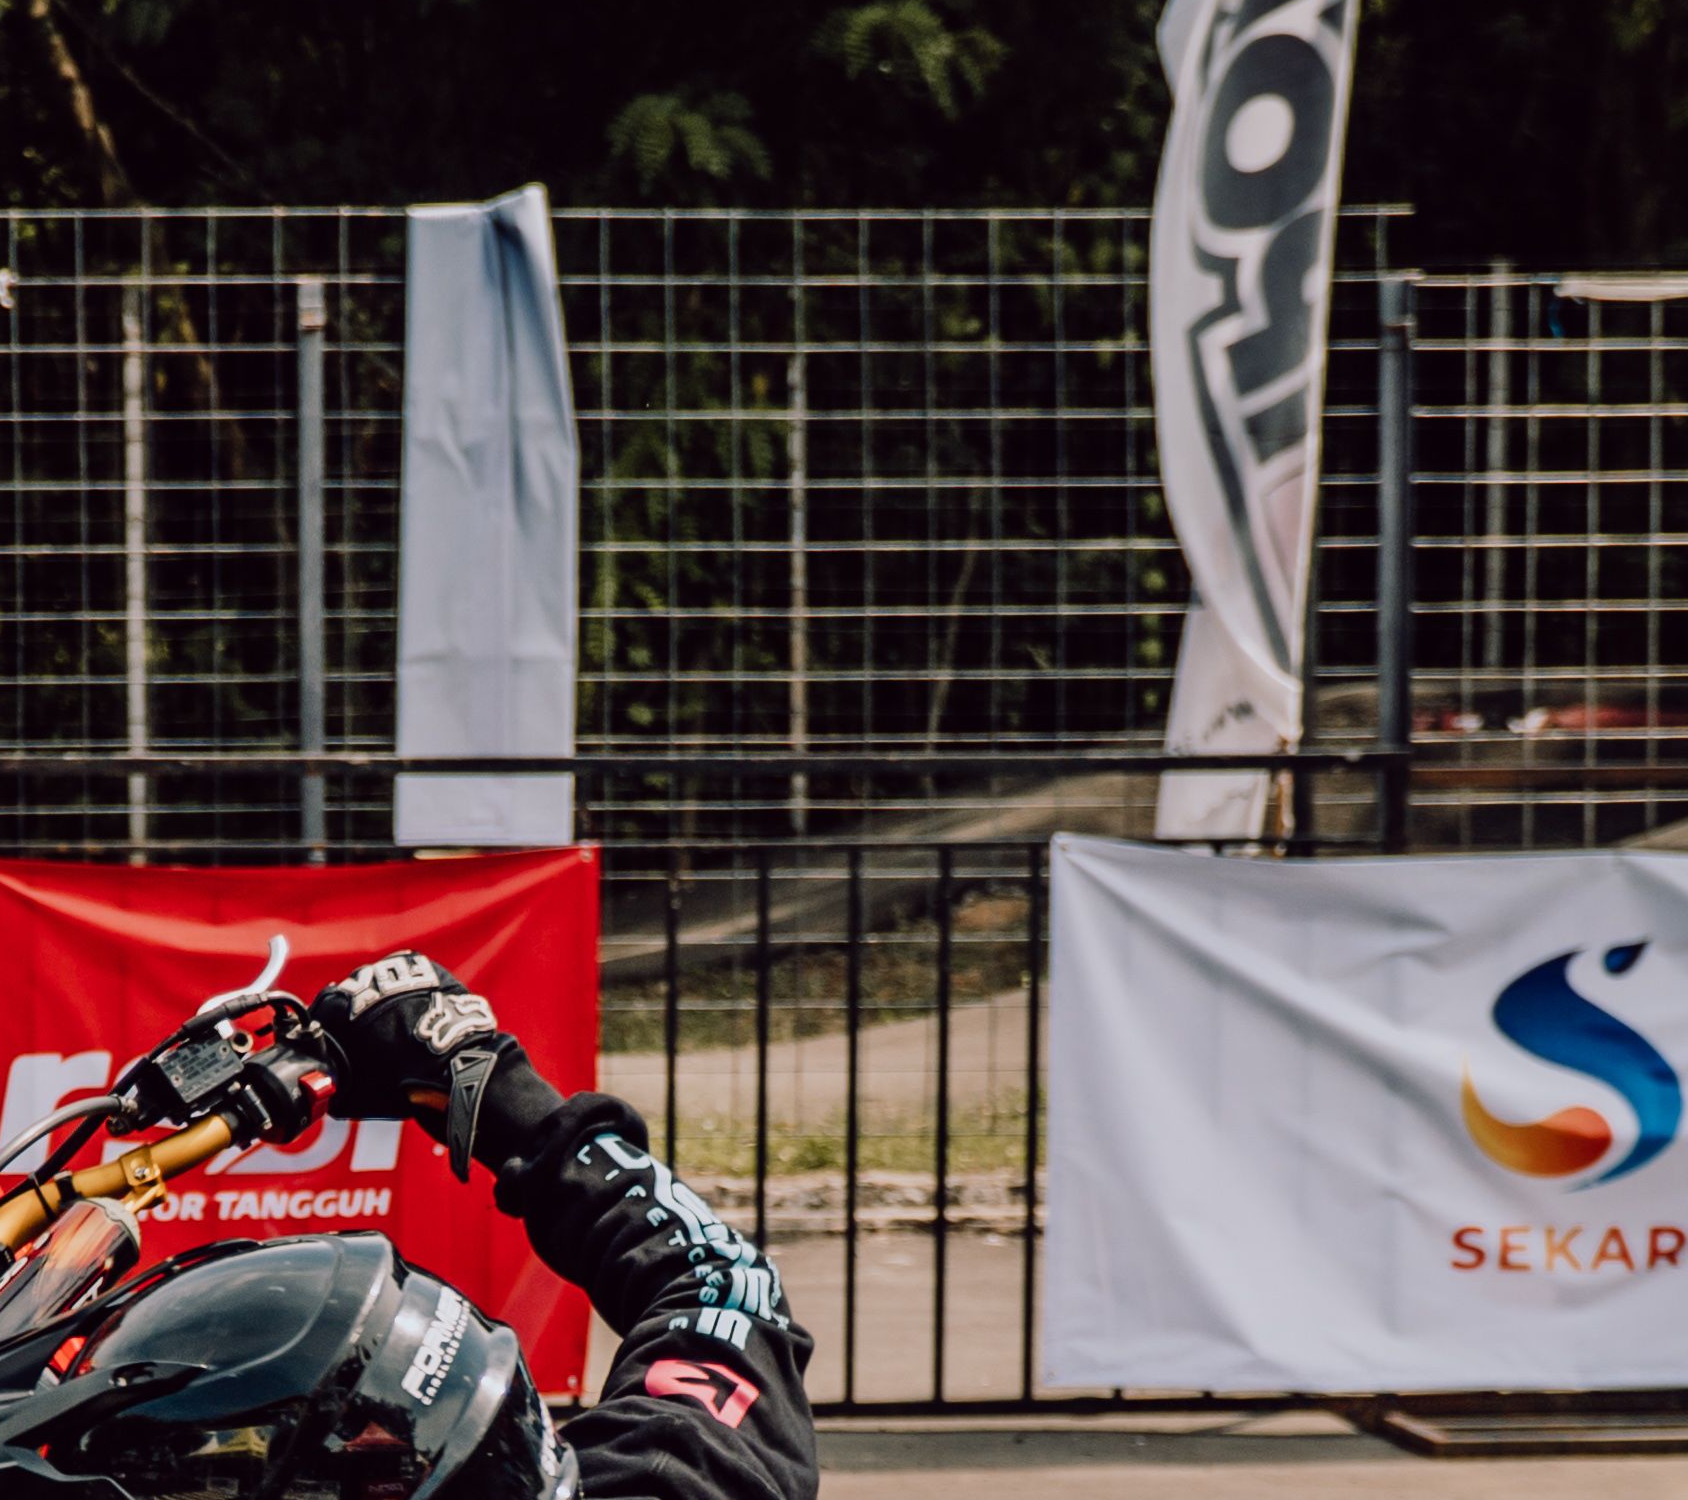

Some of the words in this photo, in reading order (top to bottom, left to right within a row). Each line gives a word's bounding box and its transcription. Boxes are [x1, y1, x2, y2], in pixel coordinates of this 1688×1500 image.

[337, 954, 440, 1021] FOX
[214, 1187, 392, 1221] TANGGUH
[1450, 1224, 1685, 1272] SEKAR
